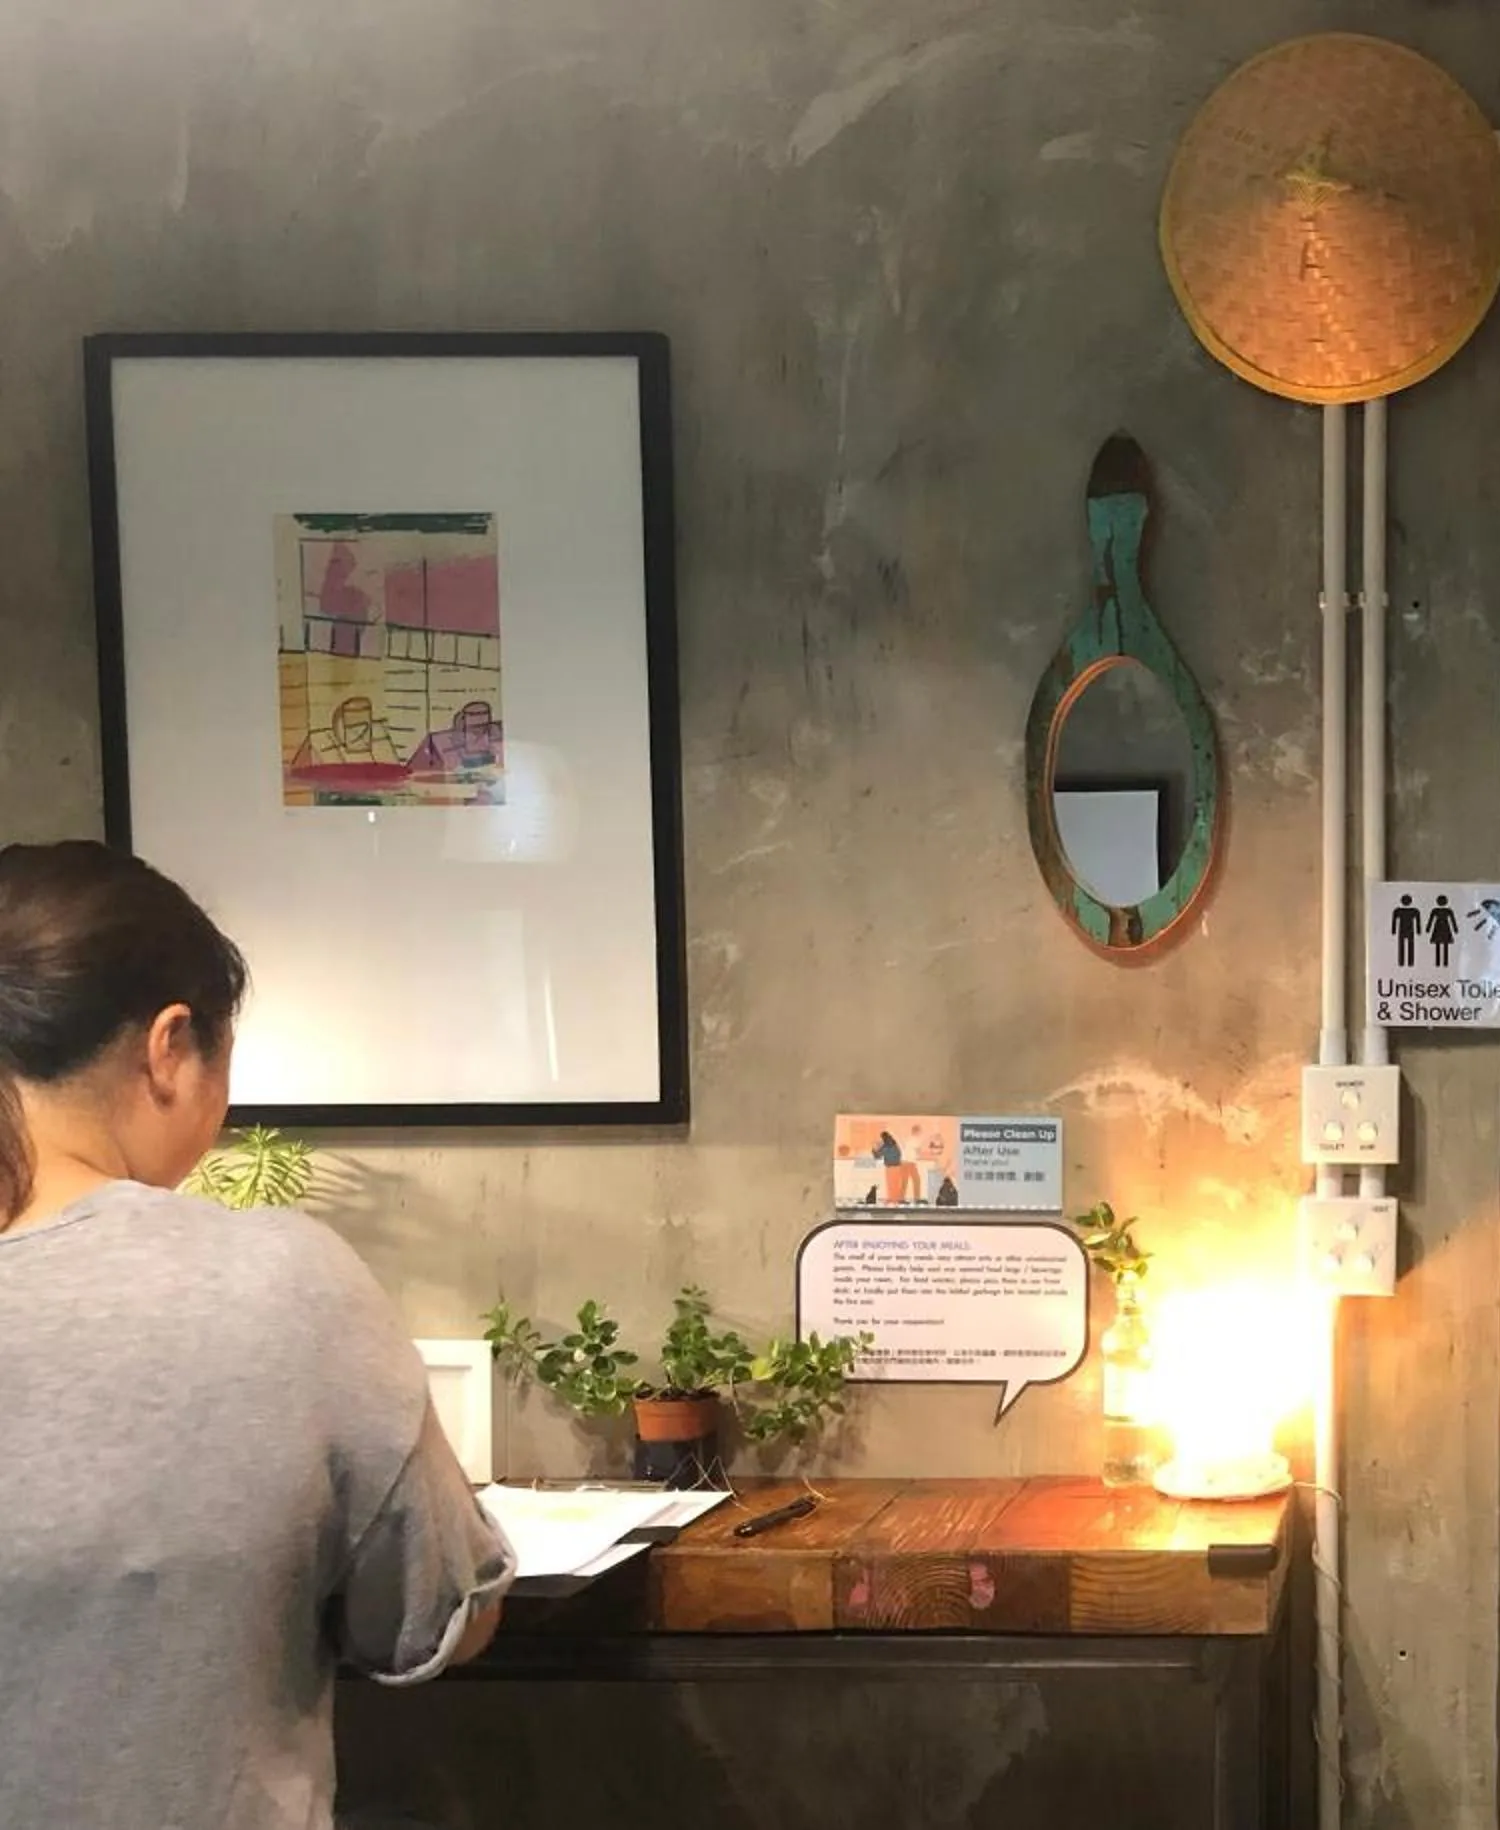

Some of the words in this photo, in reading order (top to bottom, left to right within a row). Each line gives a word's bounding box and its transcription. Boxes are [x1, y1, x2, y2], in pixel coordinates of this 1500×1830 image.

[1377, 978, 1451, 998] Unisex
[1377, 1001, 1392, 1021] &
[1399, 1001, 1482, 1021] Shower
[963, 1128, 1001, 1139] Please
[1003, 1129, 1036, 1139] Clean
[1038, 1129, 1055, 1141] Up
[963, 1145, 993, 1155] After
[996, 1146, 1021, 1156] Use
[862, 1240, 909, 1250] ENJOYING
[912, 1240, 937, 1249] YOUR
